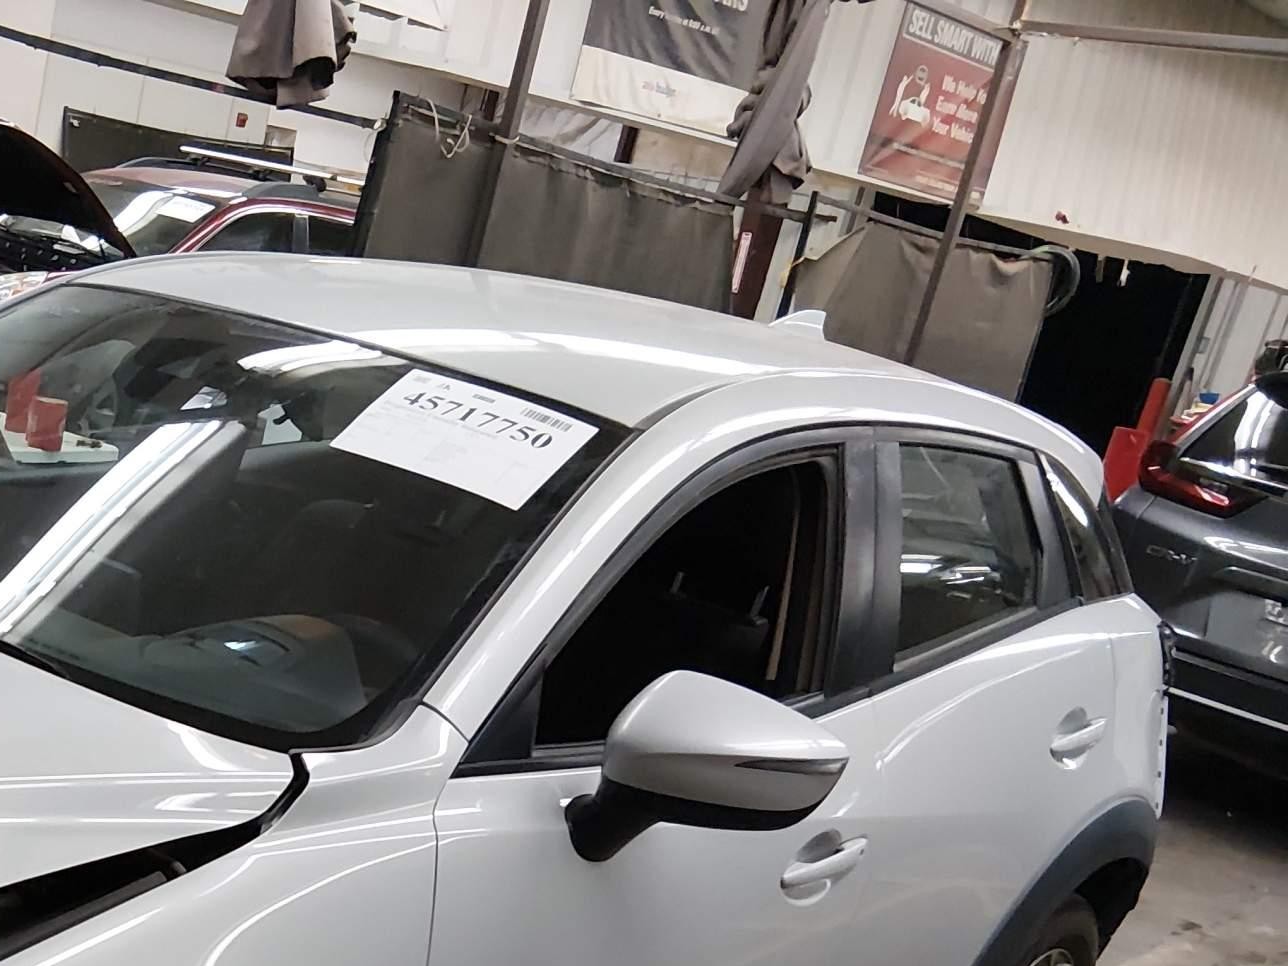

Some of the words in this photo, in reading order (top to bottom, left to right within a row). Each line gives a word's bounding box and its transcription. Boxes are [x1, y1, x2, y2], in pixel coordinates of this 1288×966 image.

[909, 11, 935, 40] SELL
[933, 19, 974, 54] SMART
[971, 36, 1003, 65] WITH
[943, 75, 956, 93] We
[977, 89, 987, 105] Yo
[932, 116, 949, 135] Your
[951, 122, 973, 144] Vehic
[403, 392, 553, 448] 45717750
